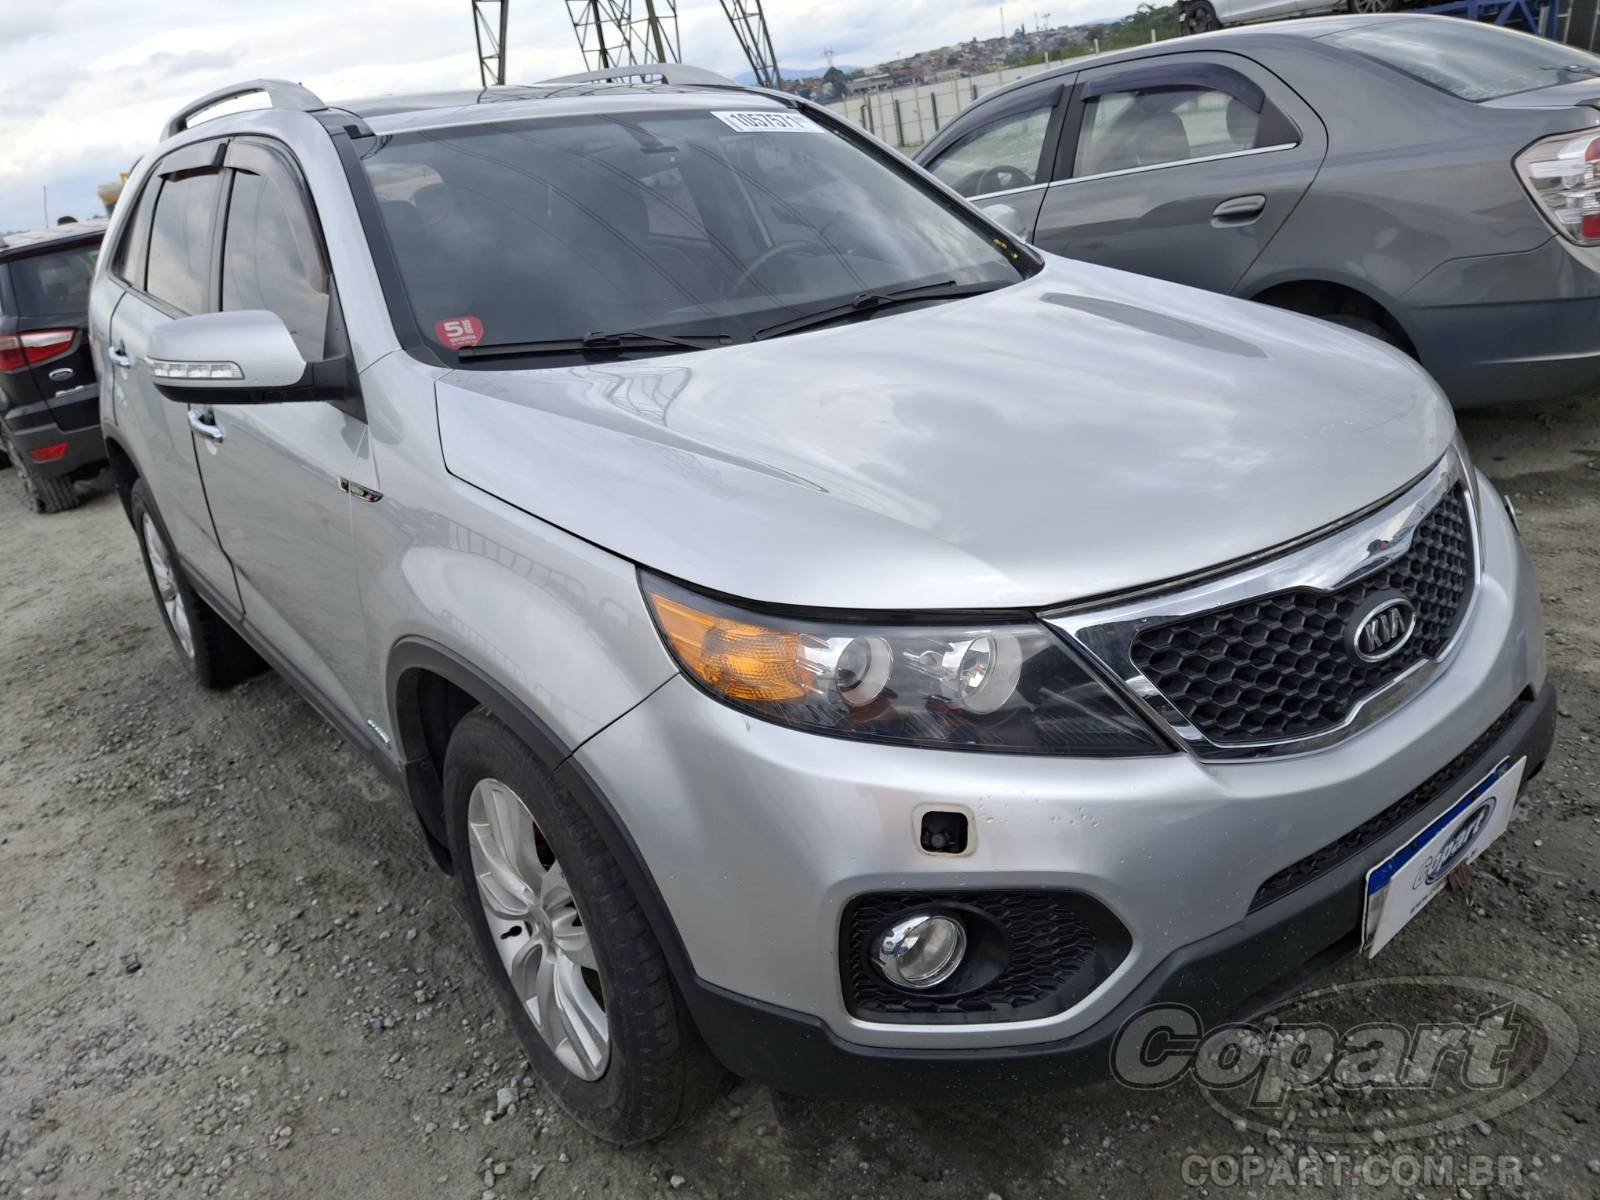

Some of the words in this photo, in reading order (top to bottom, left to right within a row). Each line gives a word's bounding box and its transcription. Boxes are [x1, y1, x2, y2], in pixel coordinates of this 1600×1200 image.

[729, 113, 804, 128] 1057571
[444, 321, 463, 337] 5
[1412, 806, 1488, 889] Copart
